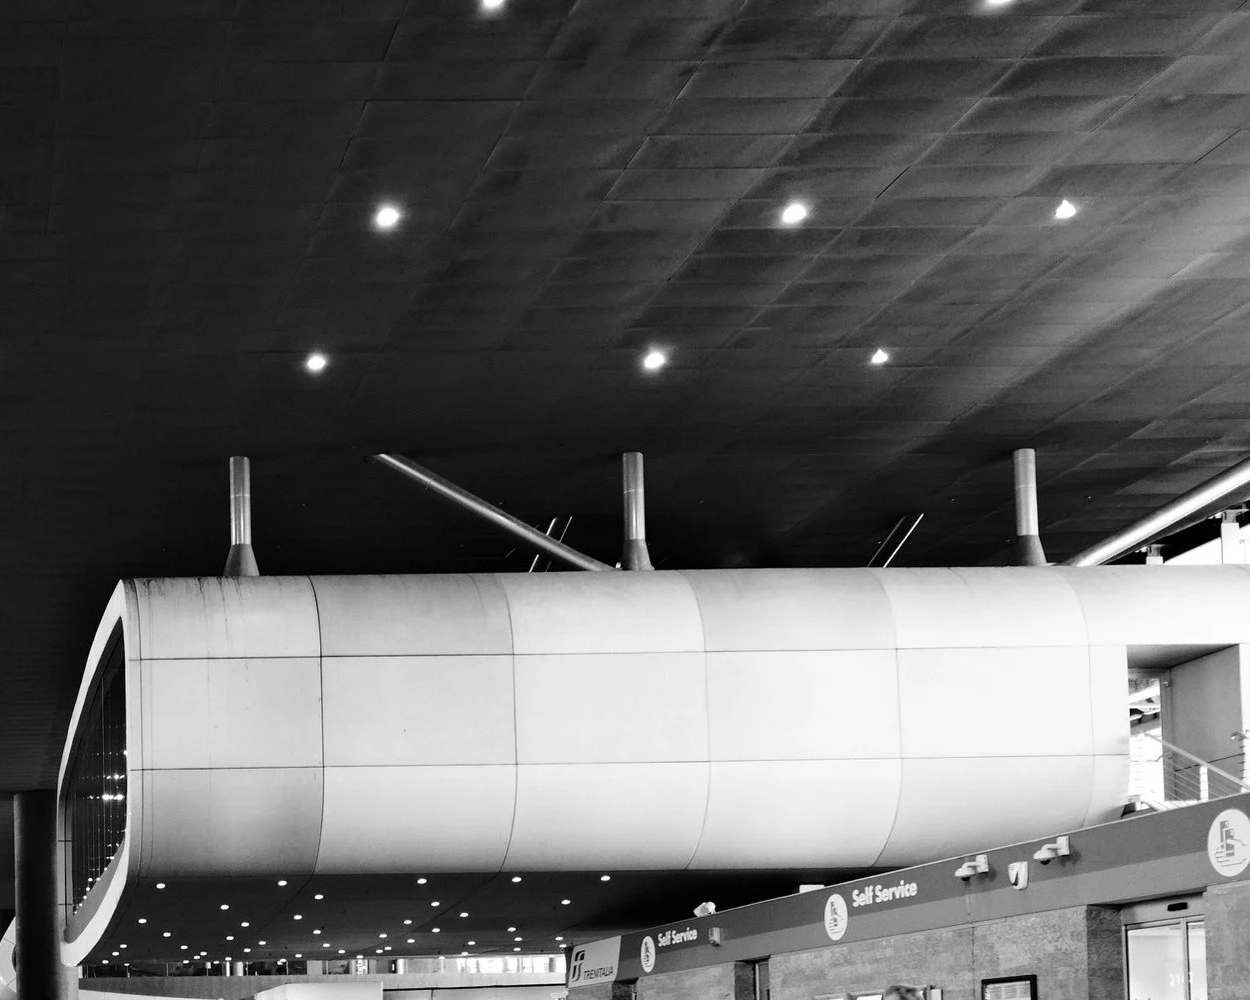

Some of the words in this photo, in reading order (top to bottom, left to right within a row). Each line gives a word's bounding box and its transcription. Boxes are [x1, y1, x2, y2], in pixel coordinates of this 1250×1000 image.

[852, 885, 873, 907] Self
[875, 880, 917, 903] Service
[658, 930, 671, 947] Self
[671, 926, 697, 945] Service
[583, 965, 614, 980] TRENITALIA
